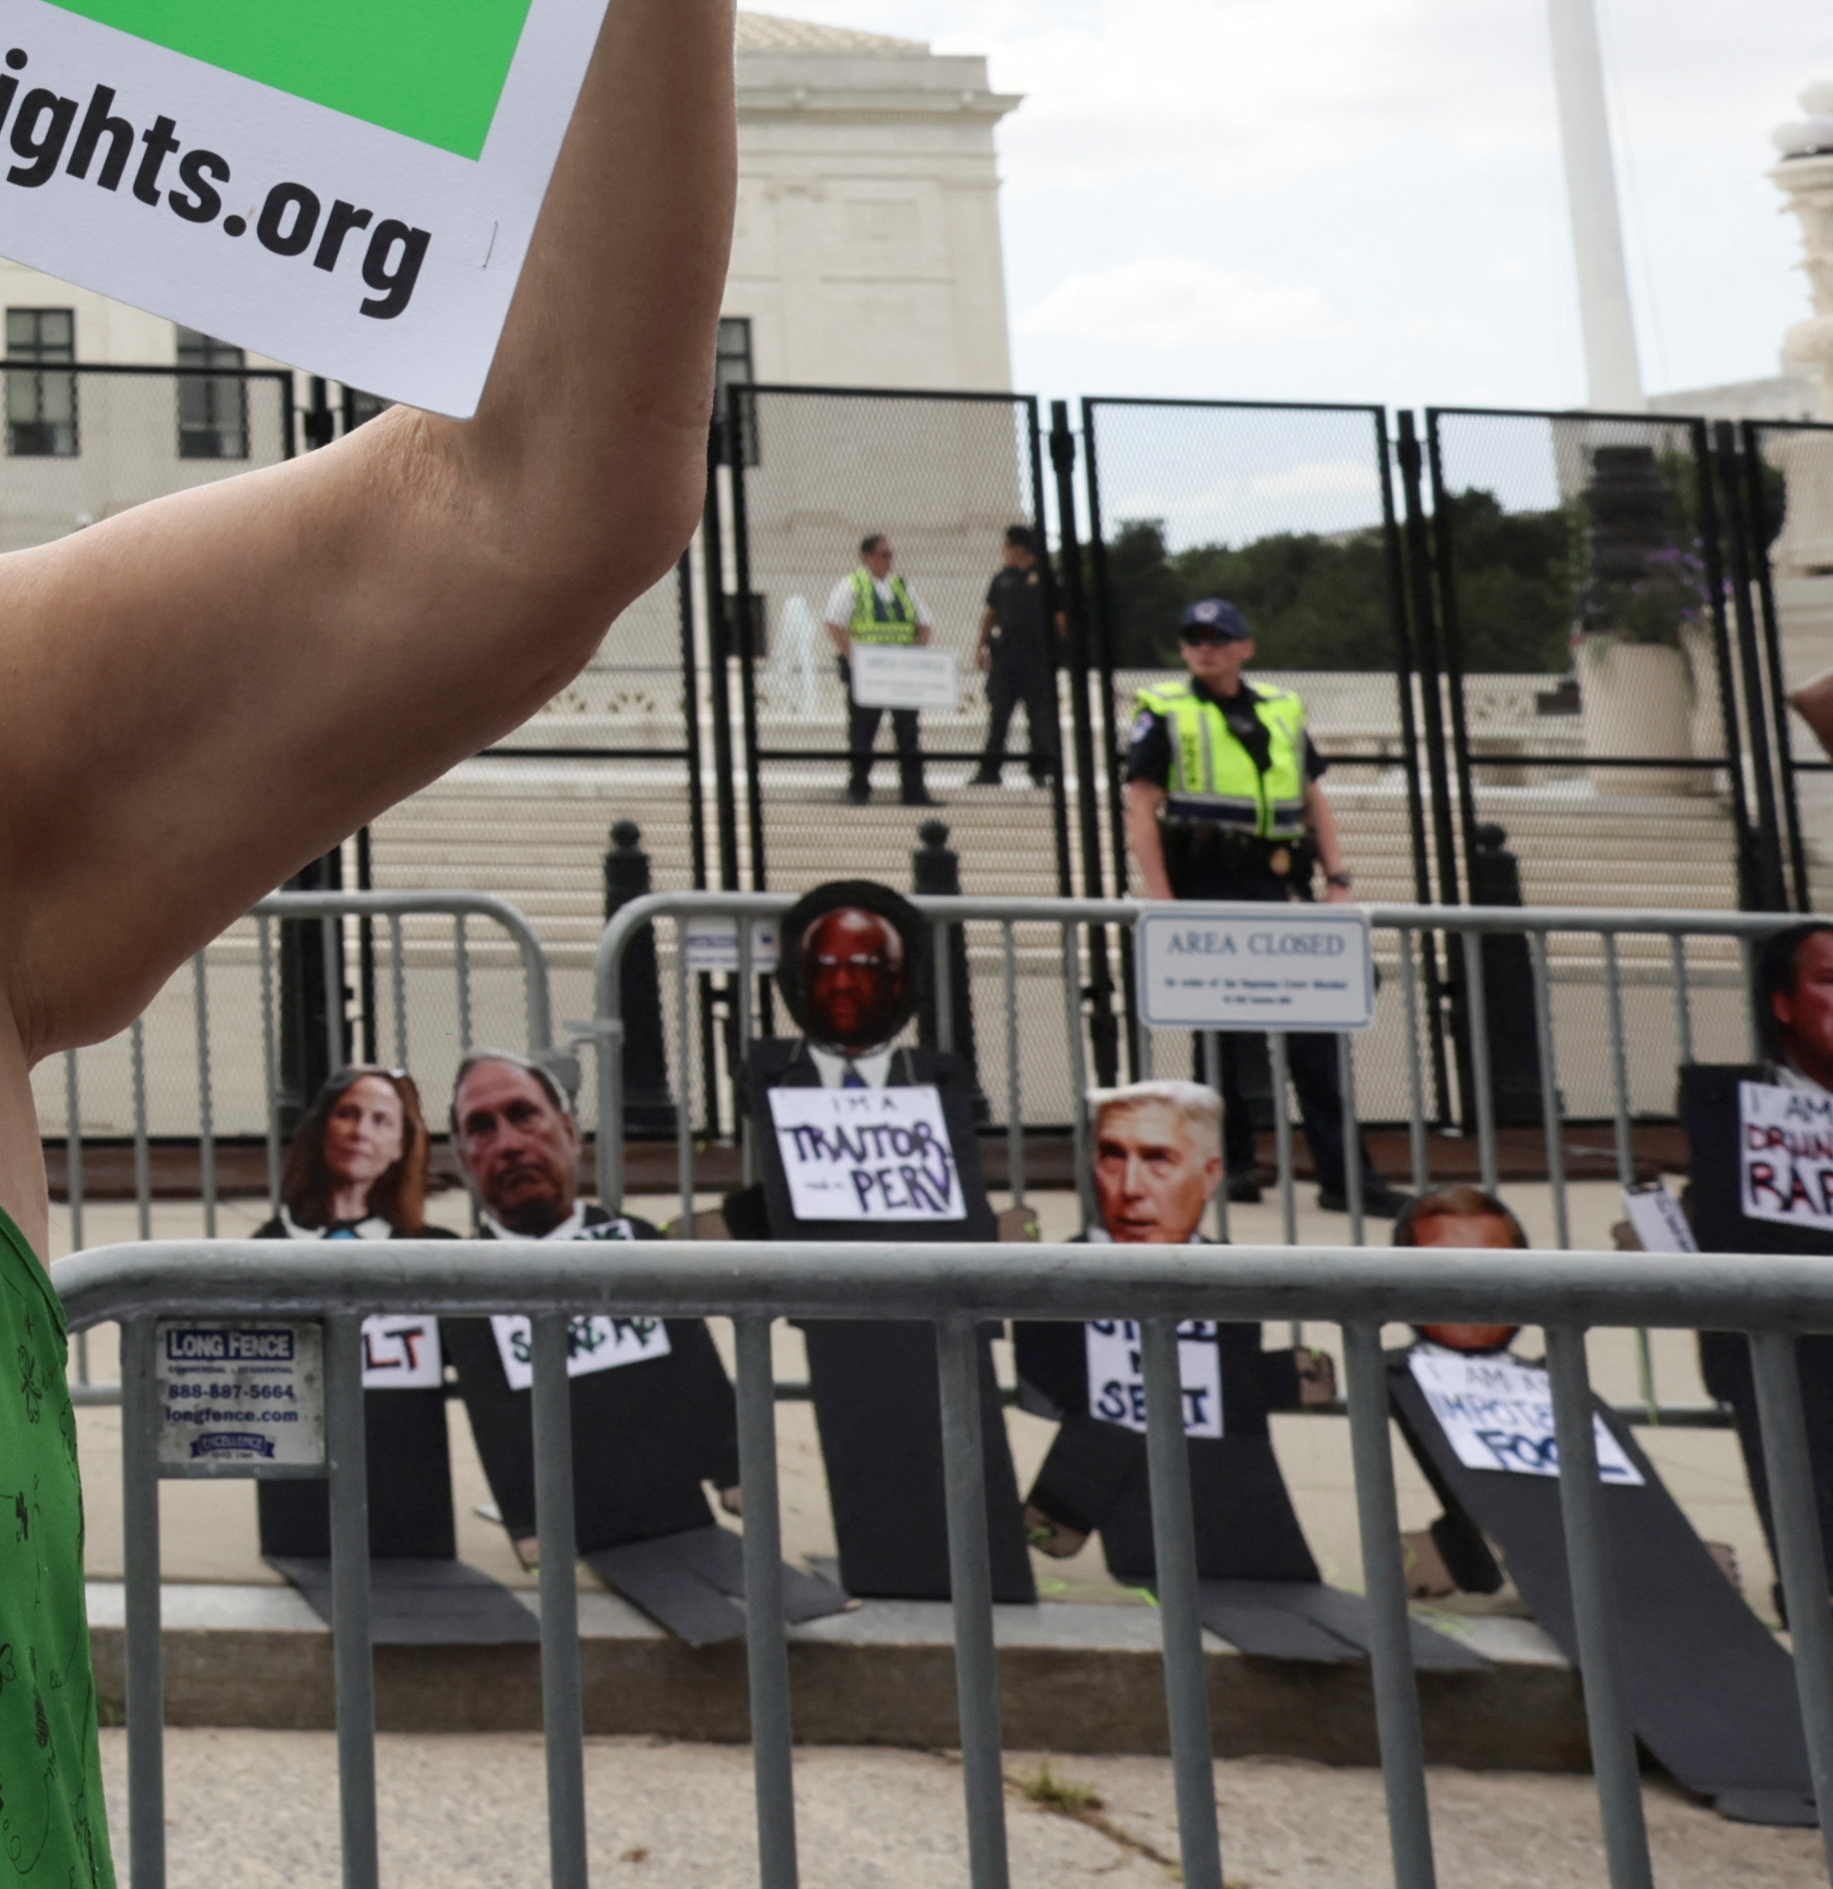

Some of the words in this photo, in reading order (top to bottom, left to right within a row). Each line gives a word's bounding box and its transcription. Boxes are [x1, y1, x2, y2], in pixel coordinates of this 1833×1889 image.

[1168, 930, 1238, 956] AREA
[1246, 931, 1346, 957] CLOSED
[881, 1095, 899, 1113] A
[779, 1121, 945, 1168] TRAITOR
[850, 1162, 951, 1214] PERV
[170, 1331, 225, 1357] LONG
[229, 1331, 291, 1357] FENCE
[169, 1384, 295, 1400] 888-887-5664
[1098, 1379, 1209, 1425] SET
[166, 1405, 299, 1426] longfence.com
[1431, 1387, 1557, 1430] IMPOTE
